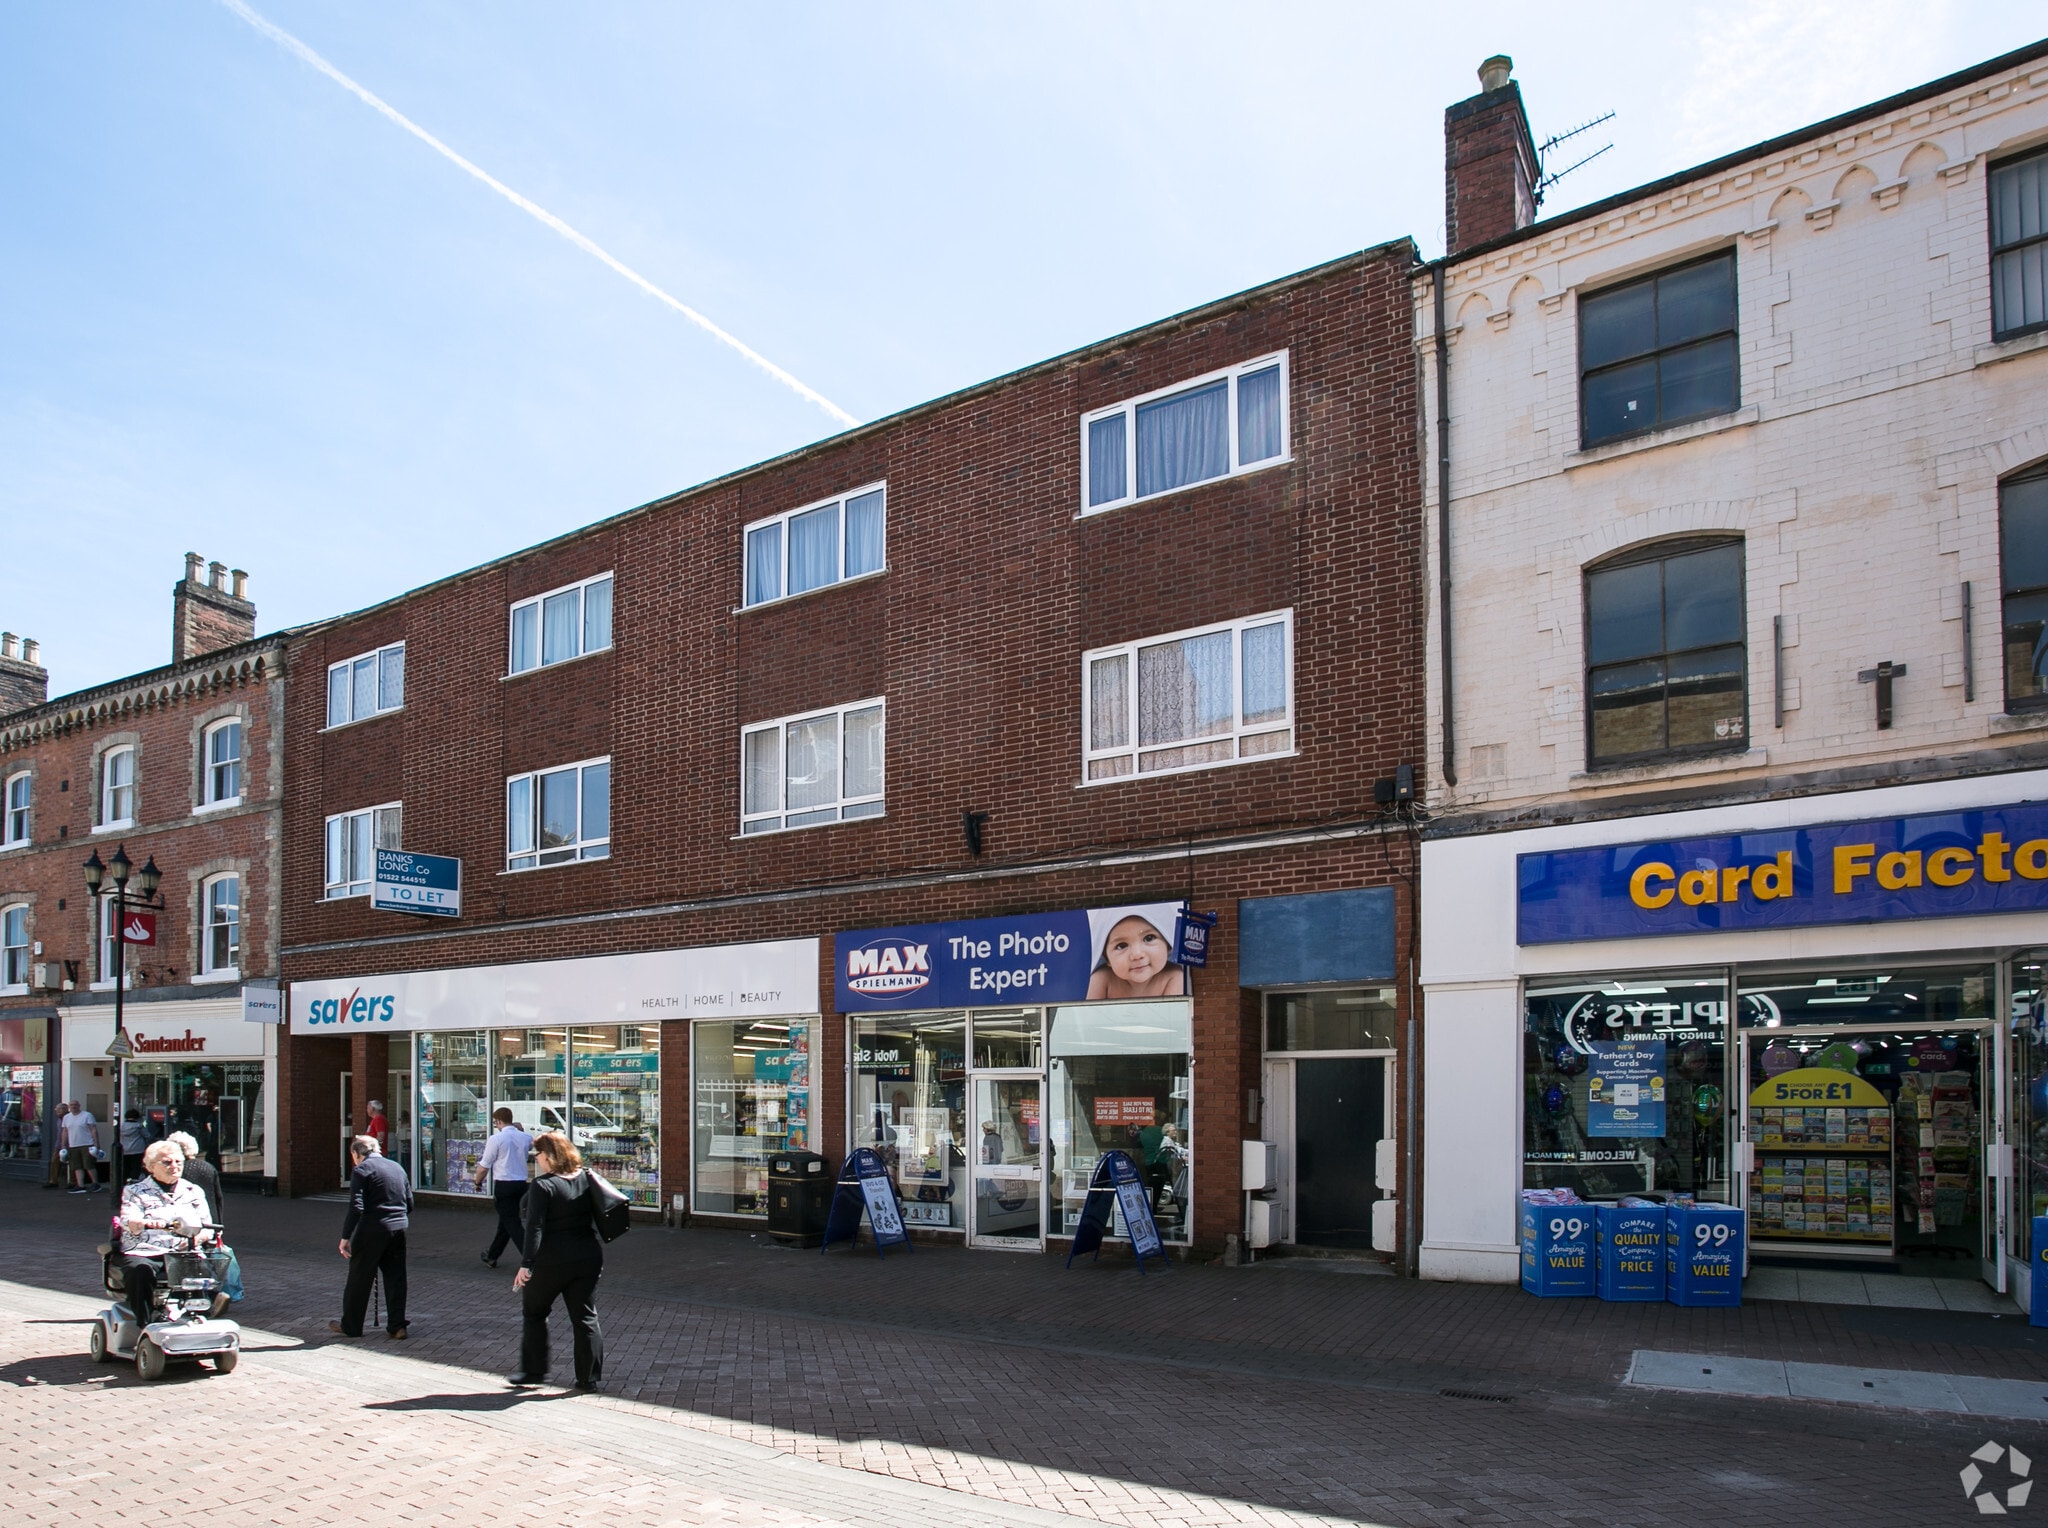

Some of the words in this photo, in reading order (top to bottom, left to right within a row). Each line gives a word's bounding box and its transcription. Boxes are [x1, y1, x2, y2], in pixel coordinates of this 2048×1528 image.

[378, 852, 413, 864] BANKS
[378, 873, 399, 881] 01522
[401, 875, 427, 884] 544515
[1629, 850, 1794, 910] Card
[390, 887, 412, 900] TO
[418, 890, 444, 903] LET
[1185, 925, 1205, 943] MAX
[948, 935, 992, 960] The
[999, 930, 1070, 957] Photo
[847, 944, 930, 976] MAX
[855, 976, 922, 989] SPIELMANN
[969, 963, 1048, 995] Expert
[247, 1000, 277, 1010] savers
[307, 986, 395, 1025] savers
[641, 997, 679, 1008] HEALTH
[694, 994, 724, 1006] HOME
[740, 991, 782, 1003] BEAUTY
[134, 1029, 206, 1053] Santander
[610, 1057, 642, 1067] savers
[1598, 1051, 1634, 1060] Father's
[1636, 1051, 1655, 1060] Day
[1920, 1052, 1947, 1061] cards
[1613, 1059, 1640, 1067] Cards
[1775, 1083, 1789, 1100] 5
[1790, 1088, 1824, 1100] FOR
[1826, 1082, 1852, 1100] £1
[1619, 1219, 1656, 1230] COMPARE
[1614, 1233, 1661, 1246] QUALITY
[1548, 1244, 1587, 1256] Amazing
[1619, 1246, 1656, 1256] Compare
[1692, 1250, 1732, 1263] Amazing
[1549, 1256, 1585, 1268] VALUE
[1620, 1261, 1654, 1272] PRICE
[1693, 1264, 1731, 1277] VALUE
